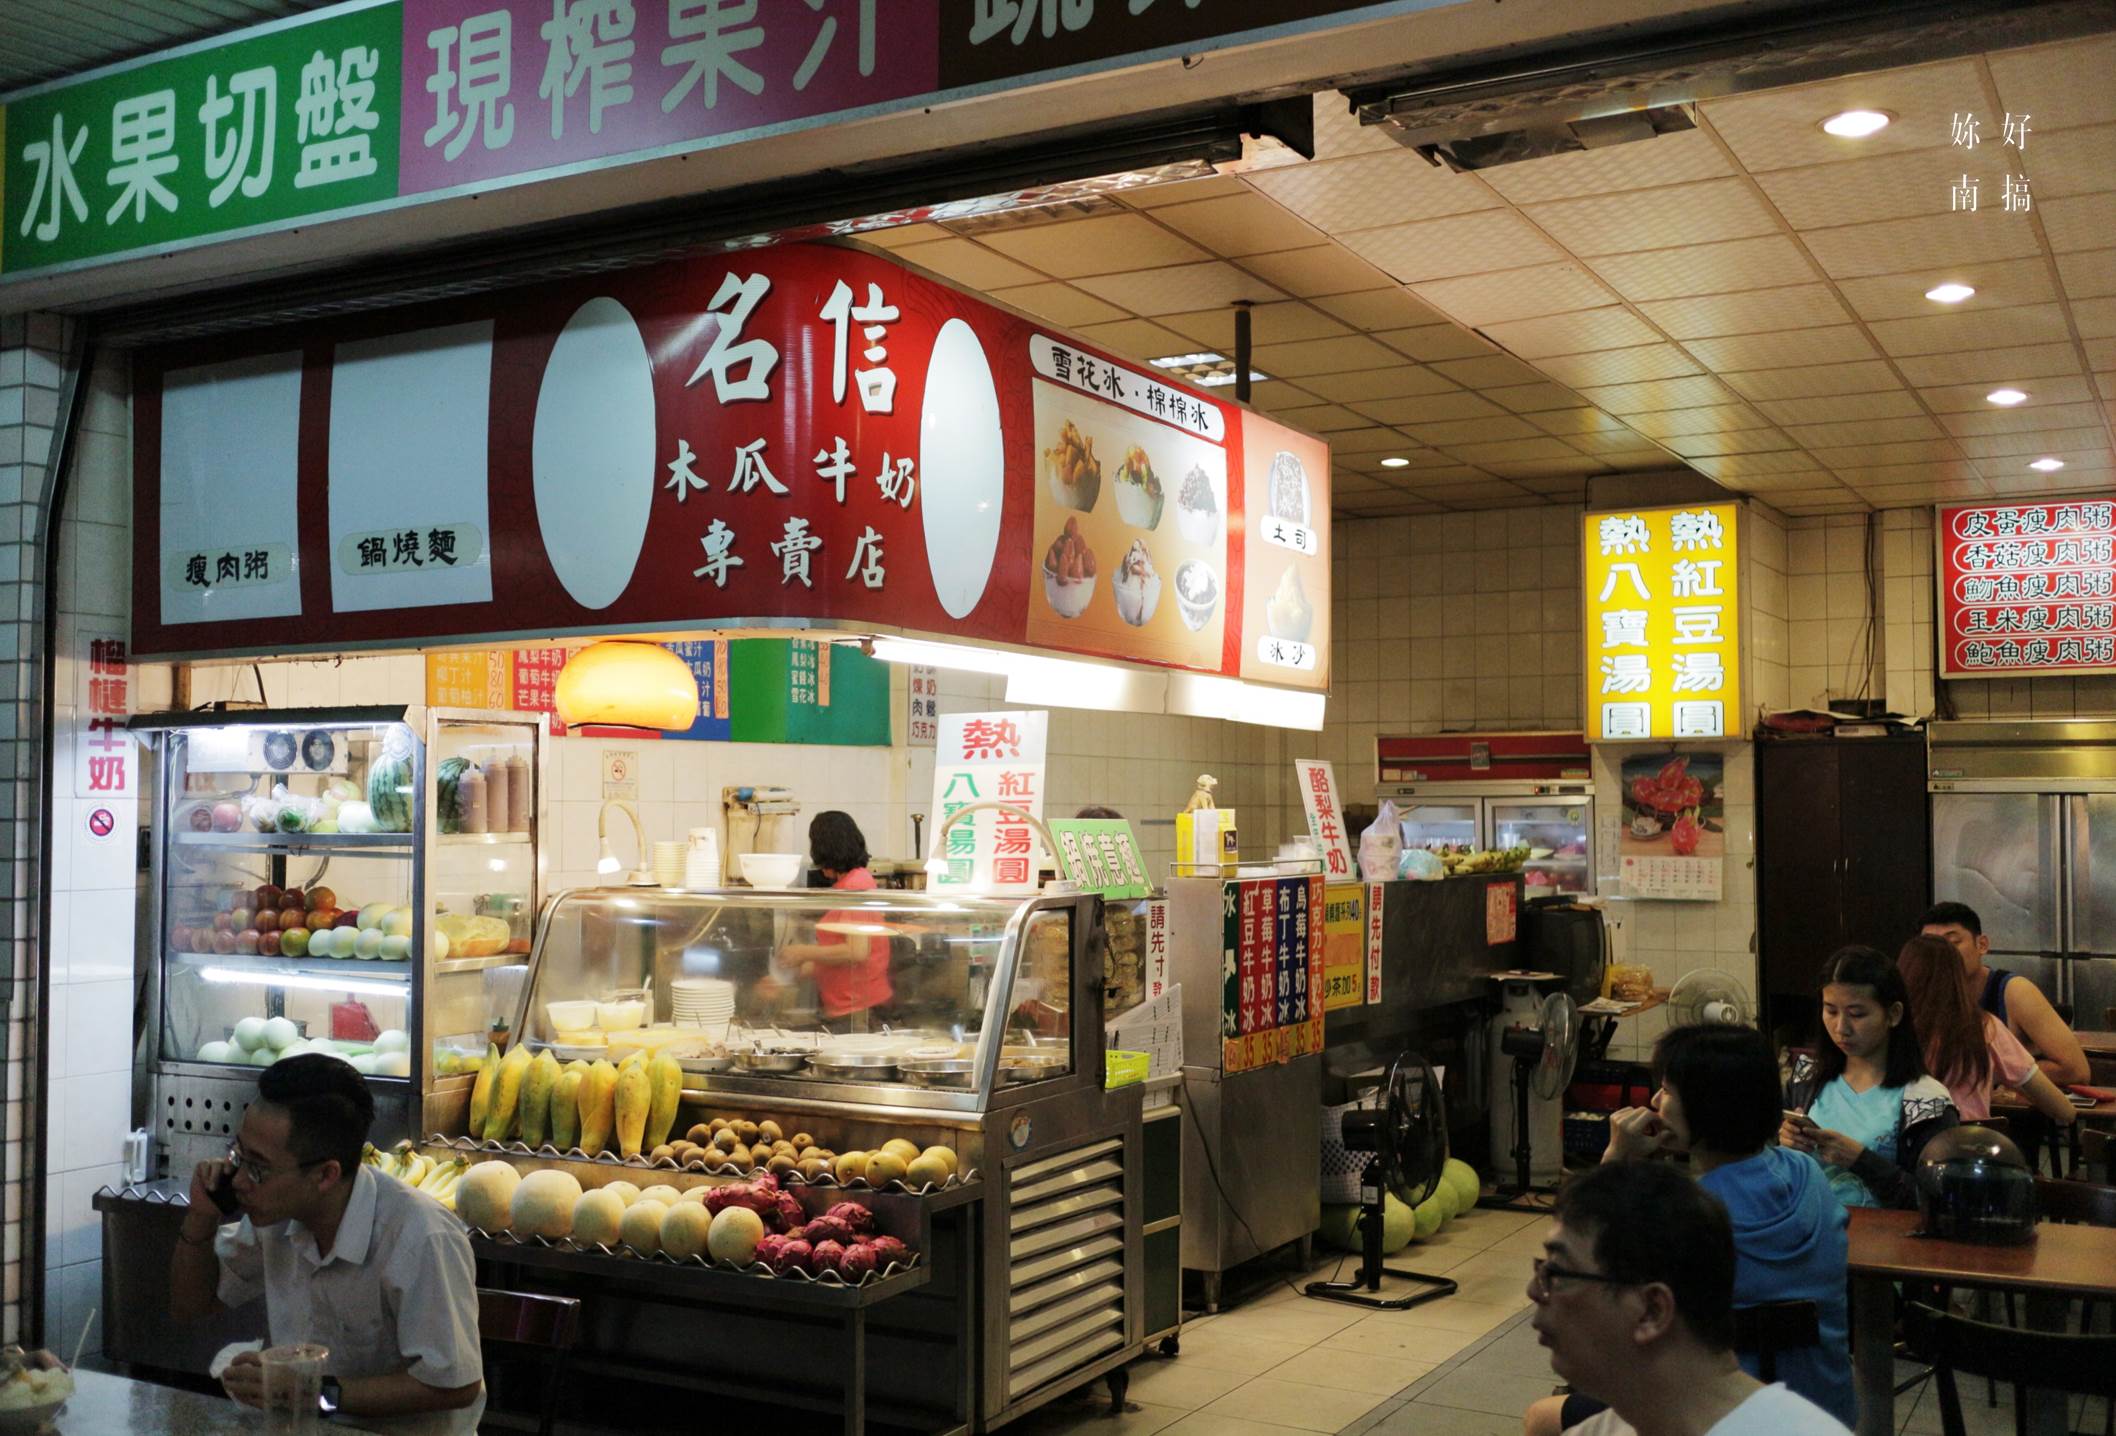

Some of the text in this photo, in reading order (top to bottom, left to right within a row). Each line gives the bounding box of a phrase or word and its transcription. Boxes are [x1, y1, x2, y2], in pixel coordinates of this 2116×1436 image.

[424, 0, 876, 161] 現榨果汁
[20, 45, 379, 241] 水果切盤
[664, 436, 914, 509] 木瓜牛奶
[357, 527, 459, 568] 鍋燒麵
[1273, 523, 1308, 550] 土司
[1963, 506, 2112, 537] 皮蛋瘦肉粥
[1964, 538, 2112, 569] 香菇瘦肉粥
[185, 550, 269, 588] 瘦肉粥
[1269, 642, 1307, 665] 冰沙
[1671, 509, 1724, 738] 熱紅豆湯圓
[1964, 637, 2114, 667] 鮑魚瘦肉粥
[1965, 604, 2113, 634] 玉米瘦肉粥
[962, 719, 1021, 760] 熱
[992, 771, 1036, 884] 紅豆湯圓
[1308, 767, 1348, 874] 酪梨牛奶
[1243, 890, 1256, 1032] 紅豆牛奶冰
[1260, 887, 1274, 1027] 草莓牛奶冰
[1278, 886, 1292, 1023] 布丁牛奶冰
[1369, 885, 1382, 1001] 請先付款
